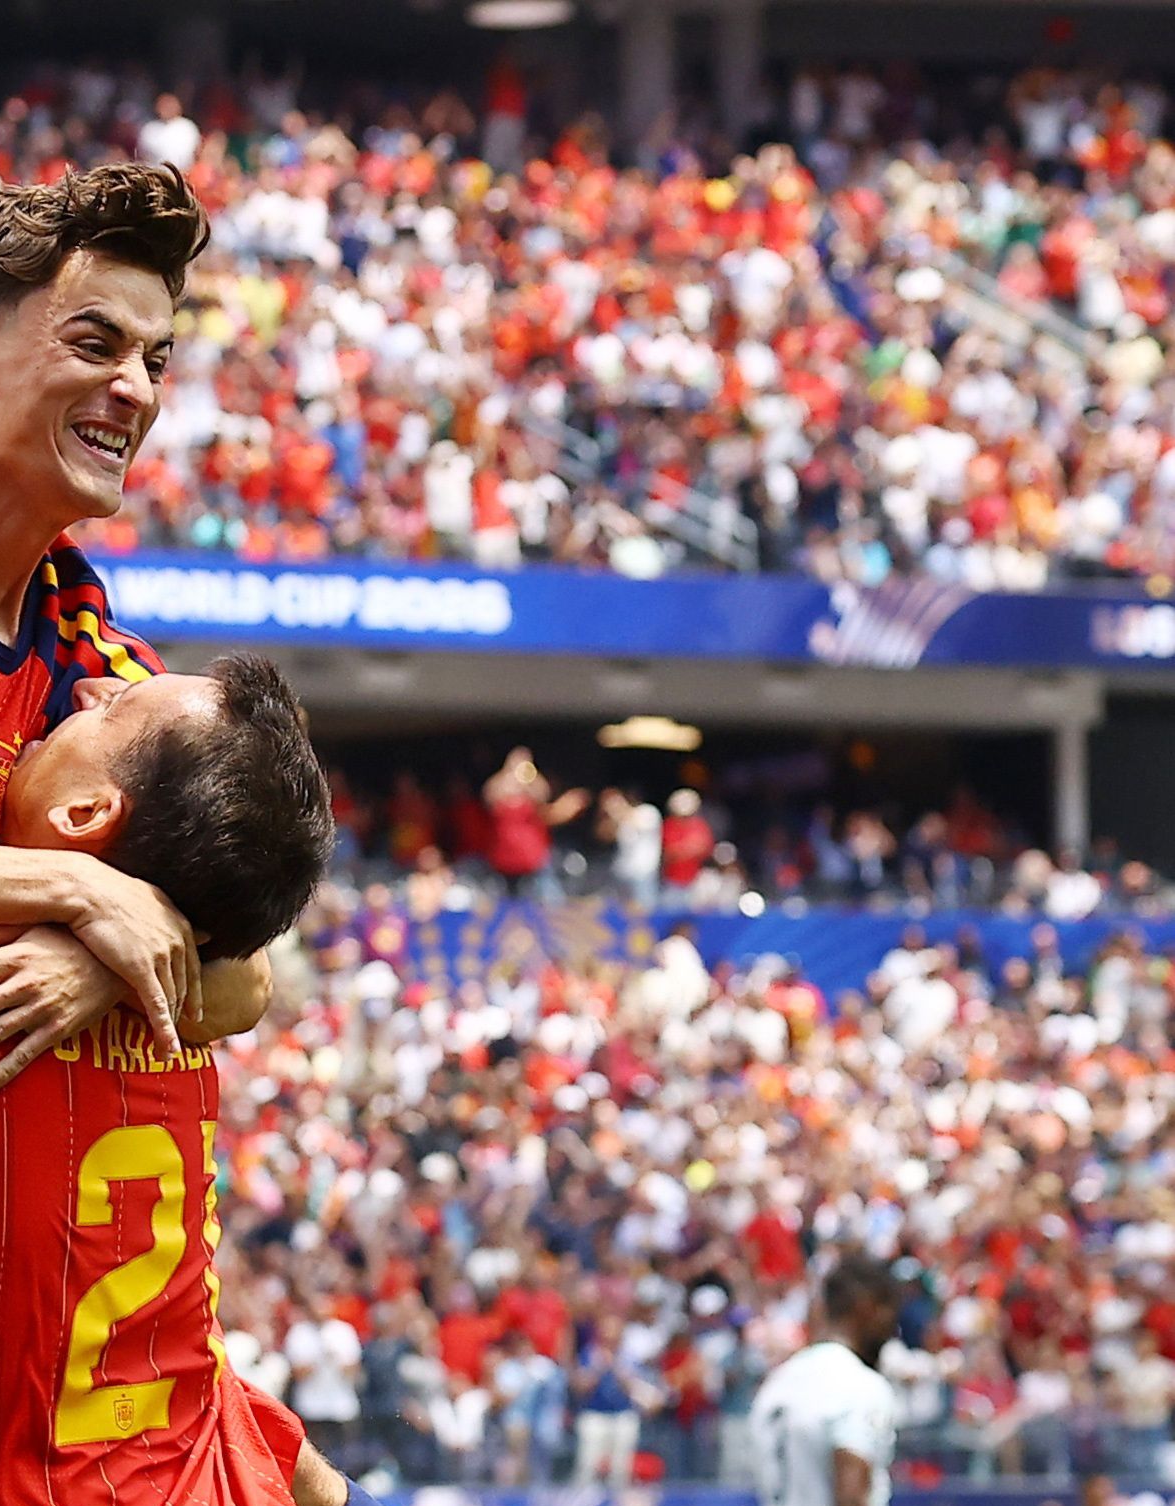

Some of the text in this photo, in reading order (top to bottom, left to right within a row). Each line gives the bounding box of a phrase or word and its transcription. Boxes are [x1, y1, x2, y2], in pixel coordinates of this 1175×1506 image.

[111, 566, 513, 635] WORLD CUP 2026
